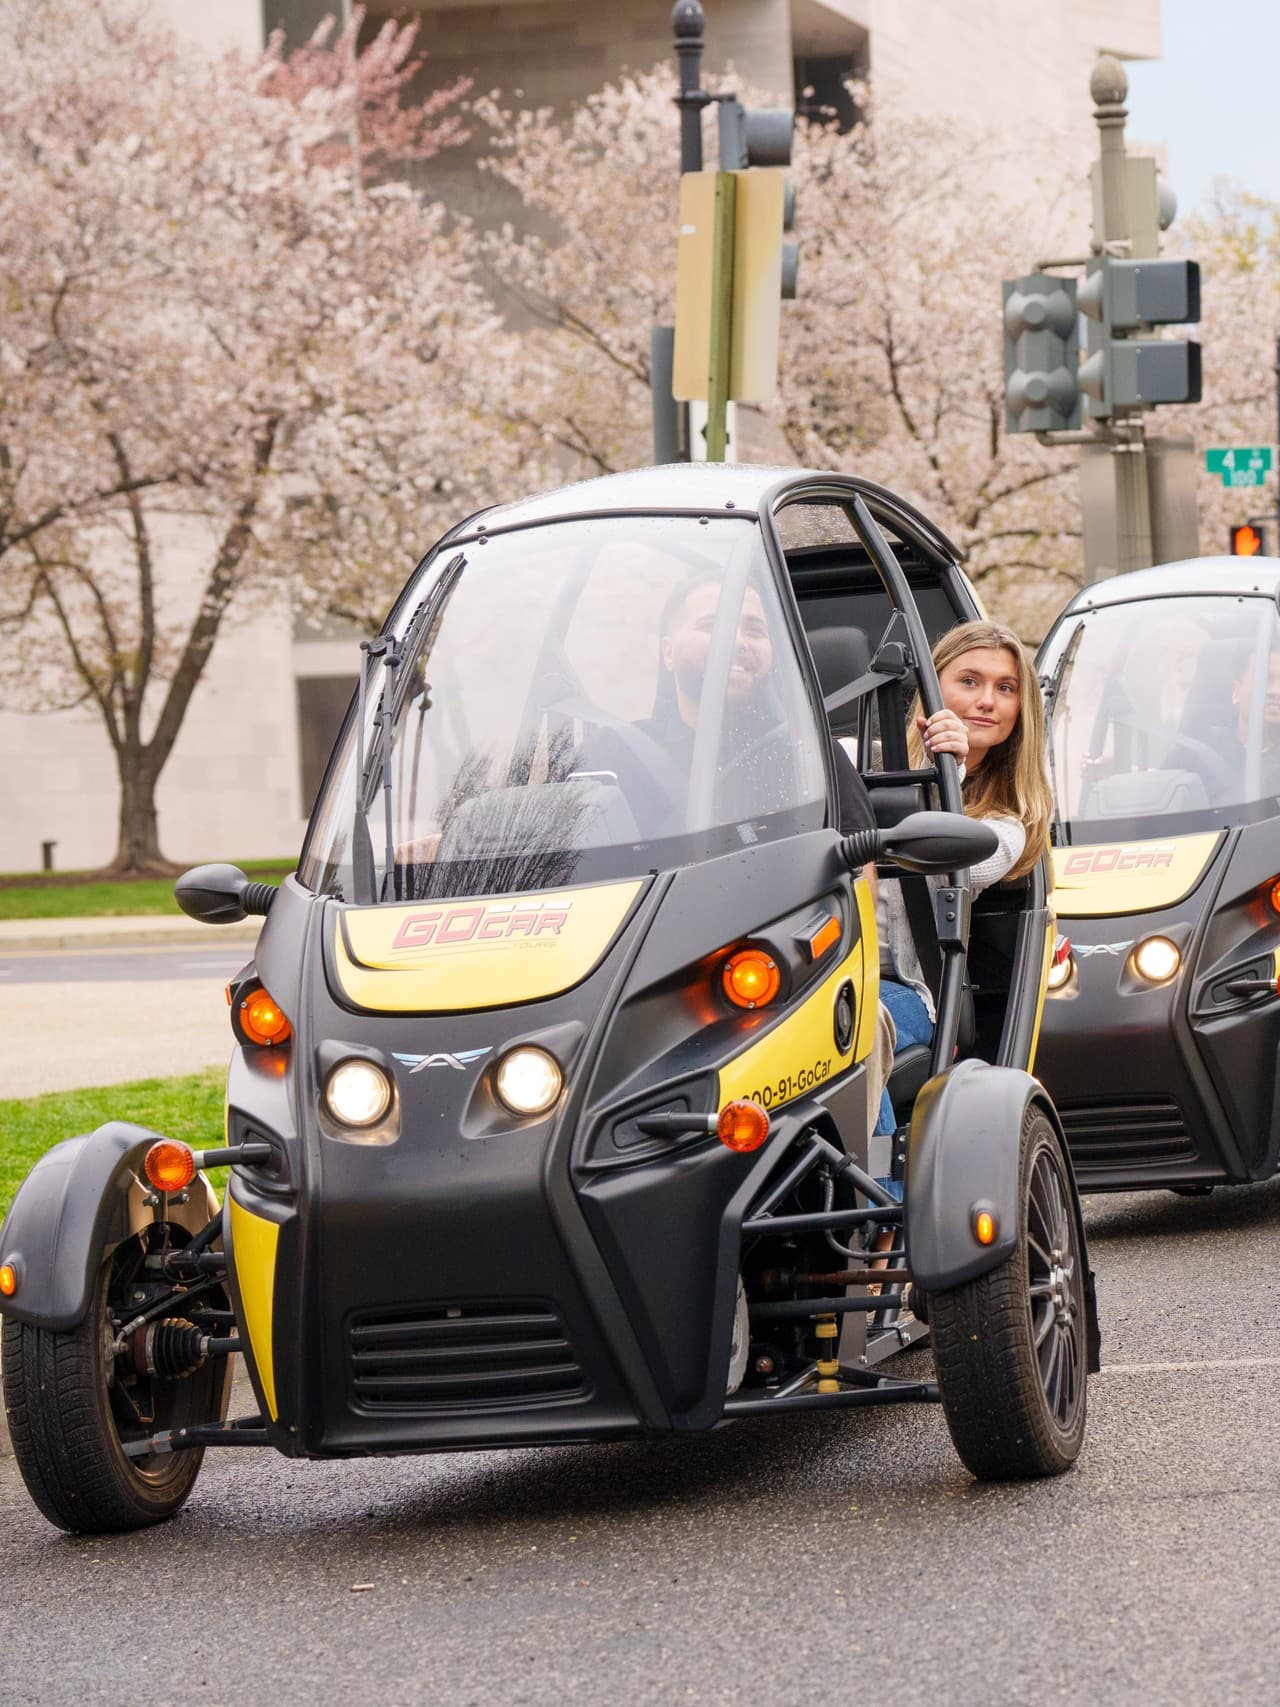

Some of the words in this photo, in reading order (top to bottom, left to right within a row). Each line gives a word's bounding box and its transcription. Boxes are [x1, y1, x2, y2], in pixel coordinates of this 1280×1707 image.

[1222, 450, 1235, 470] 4
[1064, 848, 1174, 875] GOCAR
[392, 907, 567, 949] GOCAR
